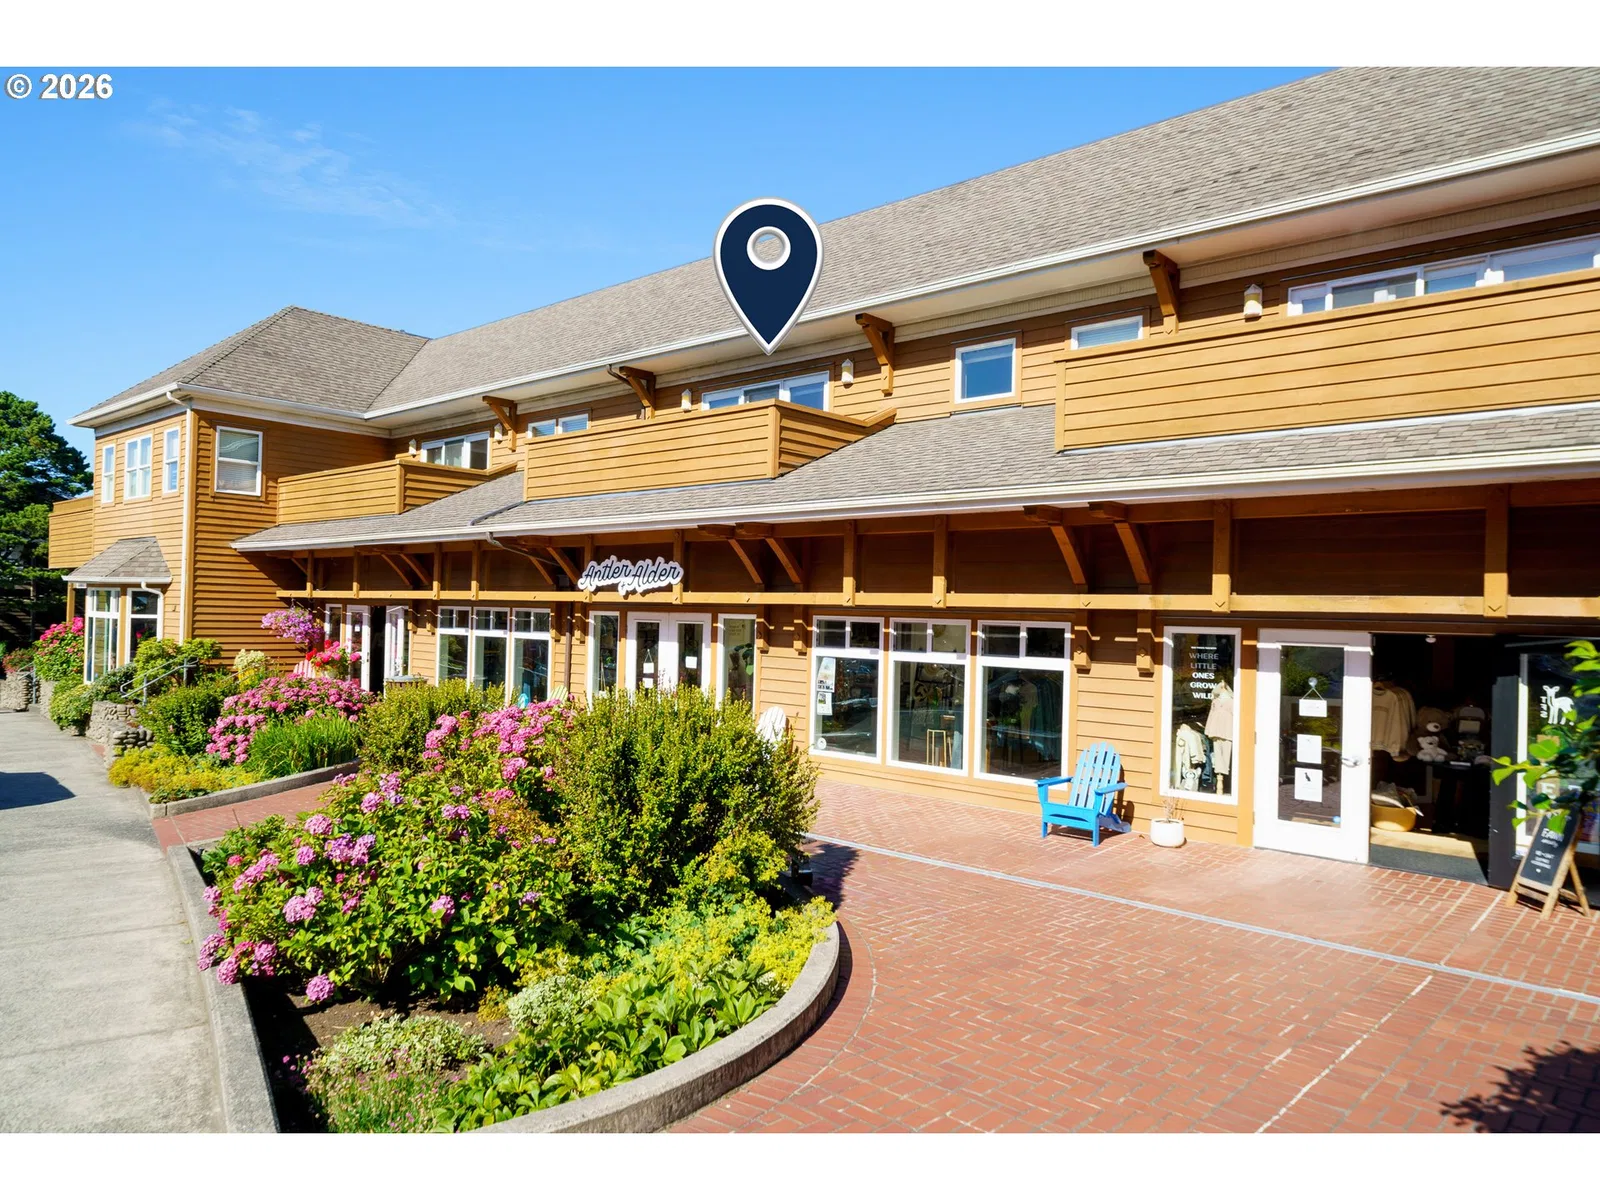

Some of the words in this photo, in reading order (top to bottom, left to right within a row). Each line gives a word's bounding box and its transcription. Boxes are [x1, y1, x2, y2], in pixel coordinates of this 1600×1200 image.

[580, 560, 633, 587] Antler
[628, 561, 681, 587] Alder
[1189, 652, 1219, 660] WHERE
[1190, 662, 1217, 670] LITTLE
[1192, 671, 1215, 680] ONES
[1190, 681, 1218, 690] GROW
[1192, 691, 1214, 700] WILD
